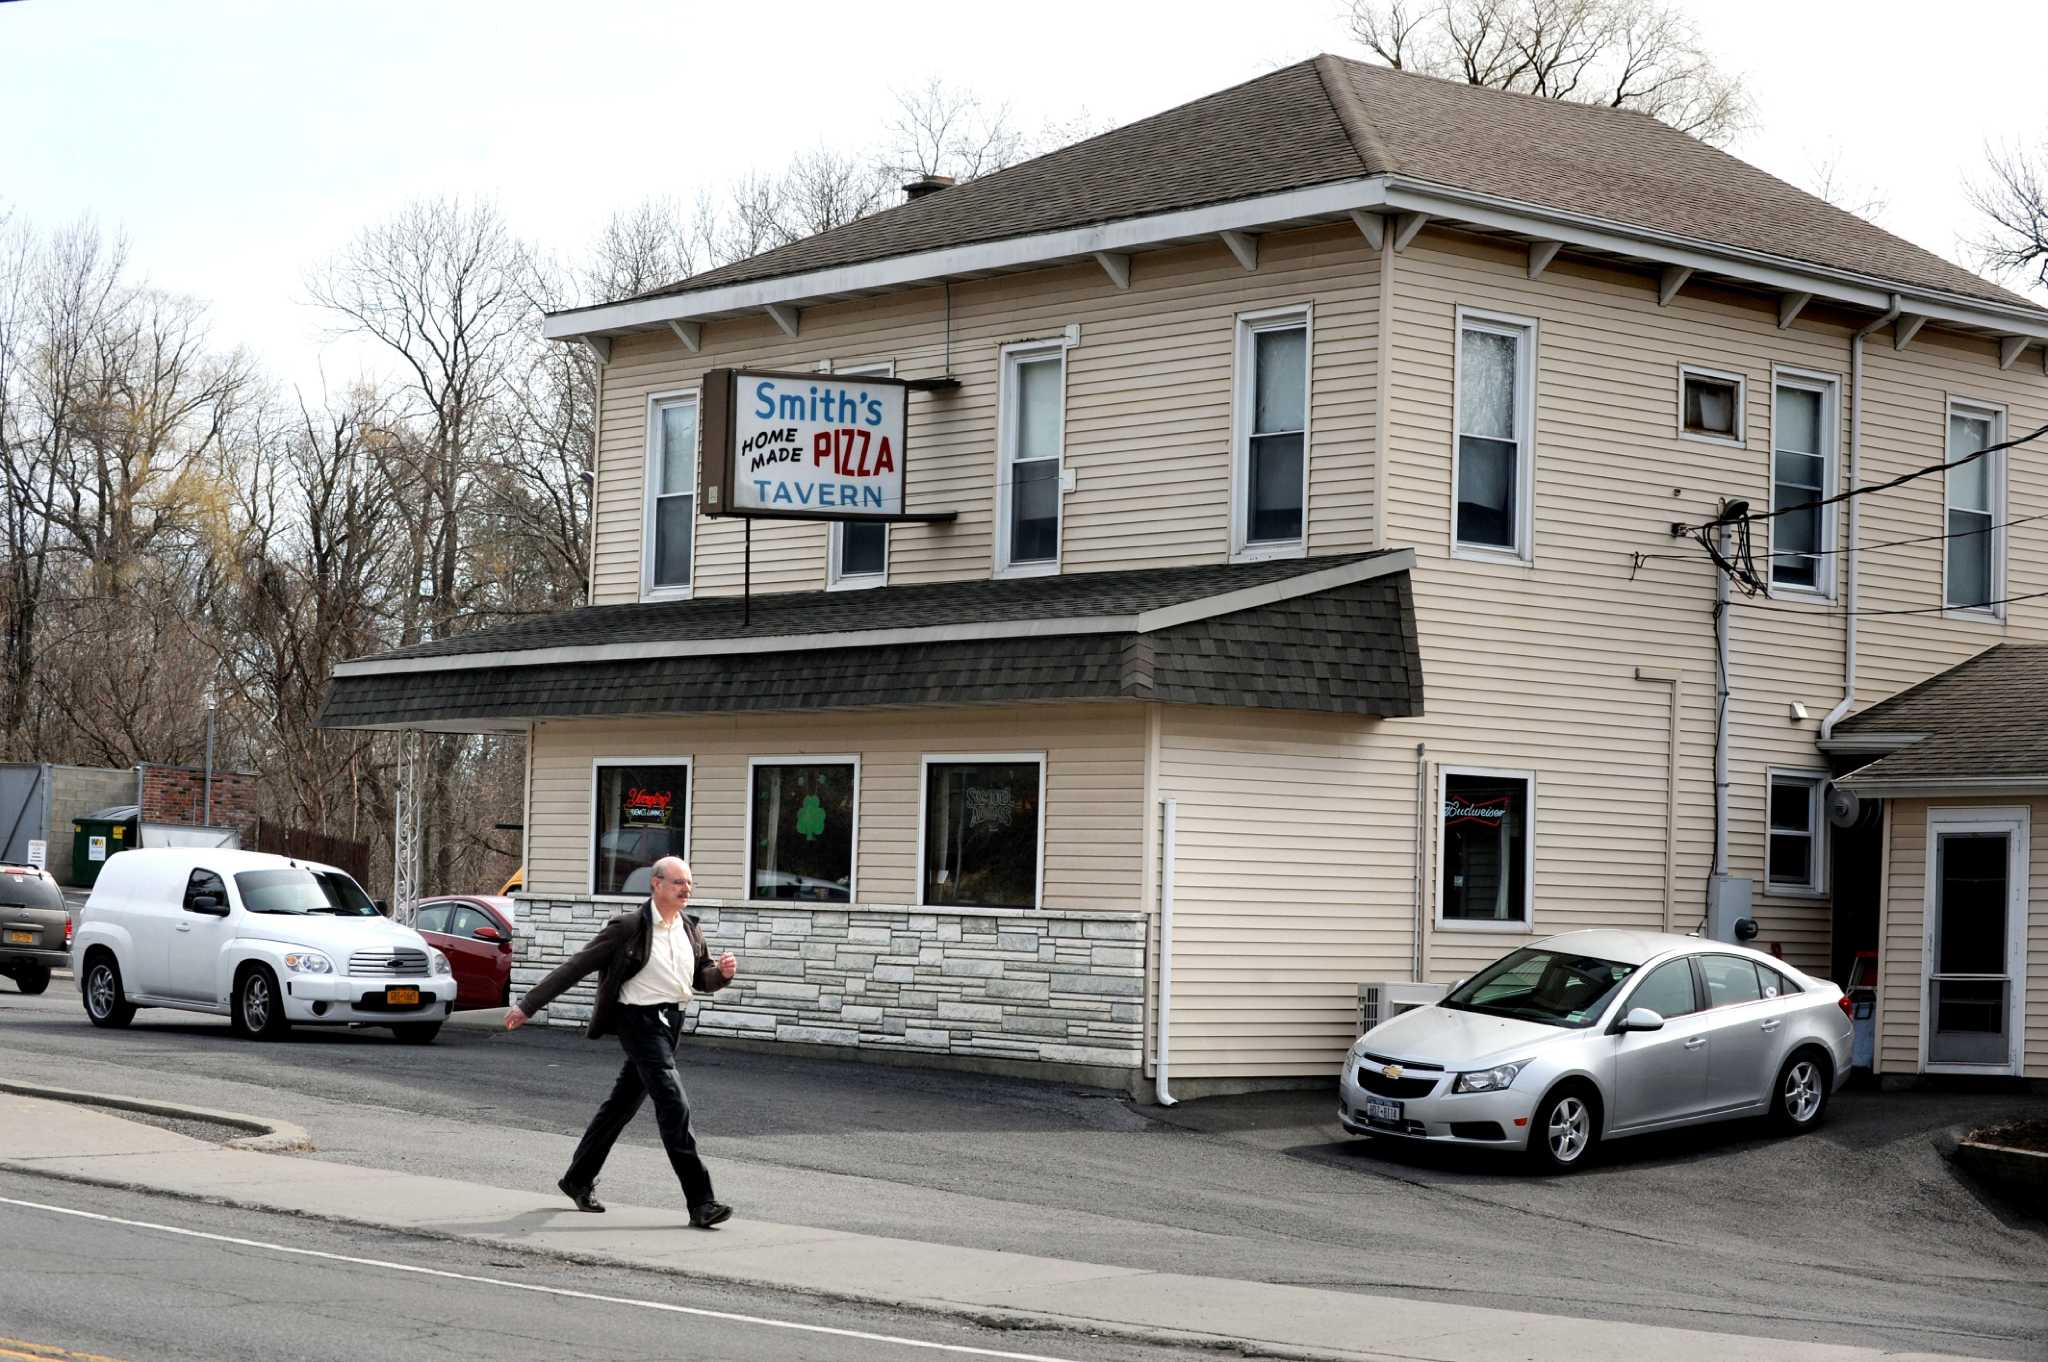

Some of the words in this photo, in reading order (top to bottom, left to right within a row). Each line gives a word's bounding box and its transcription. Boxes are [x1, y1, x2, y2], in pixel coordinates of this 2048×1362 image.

[755, 381, 883, 426] Smith's
[742, 428, 798, 456] HOME
[814, 428, 894, 477] PIZZA
[751, 448, 803, 472] MADE
[753, 480, 882, 508] TAVERN
[1444, 800, 1505, 817] Budweiser
